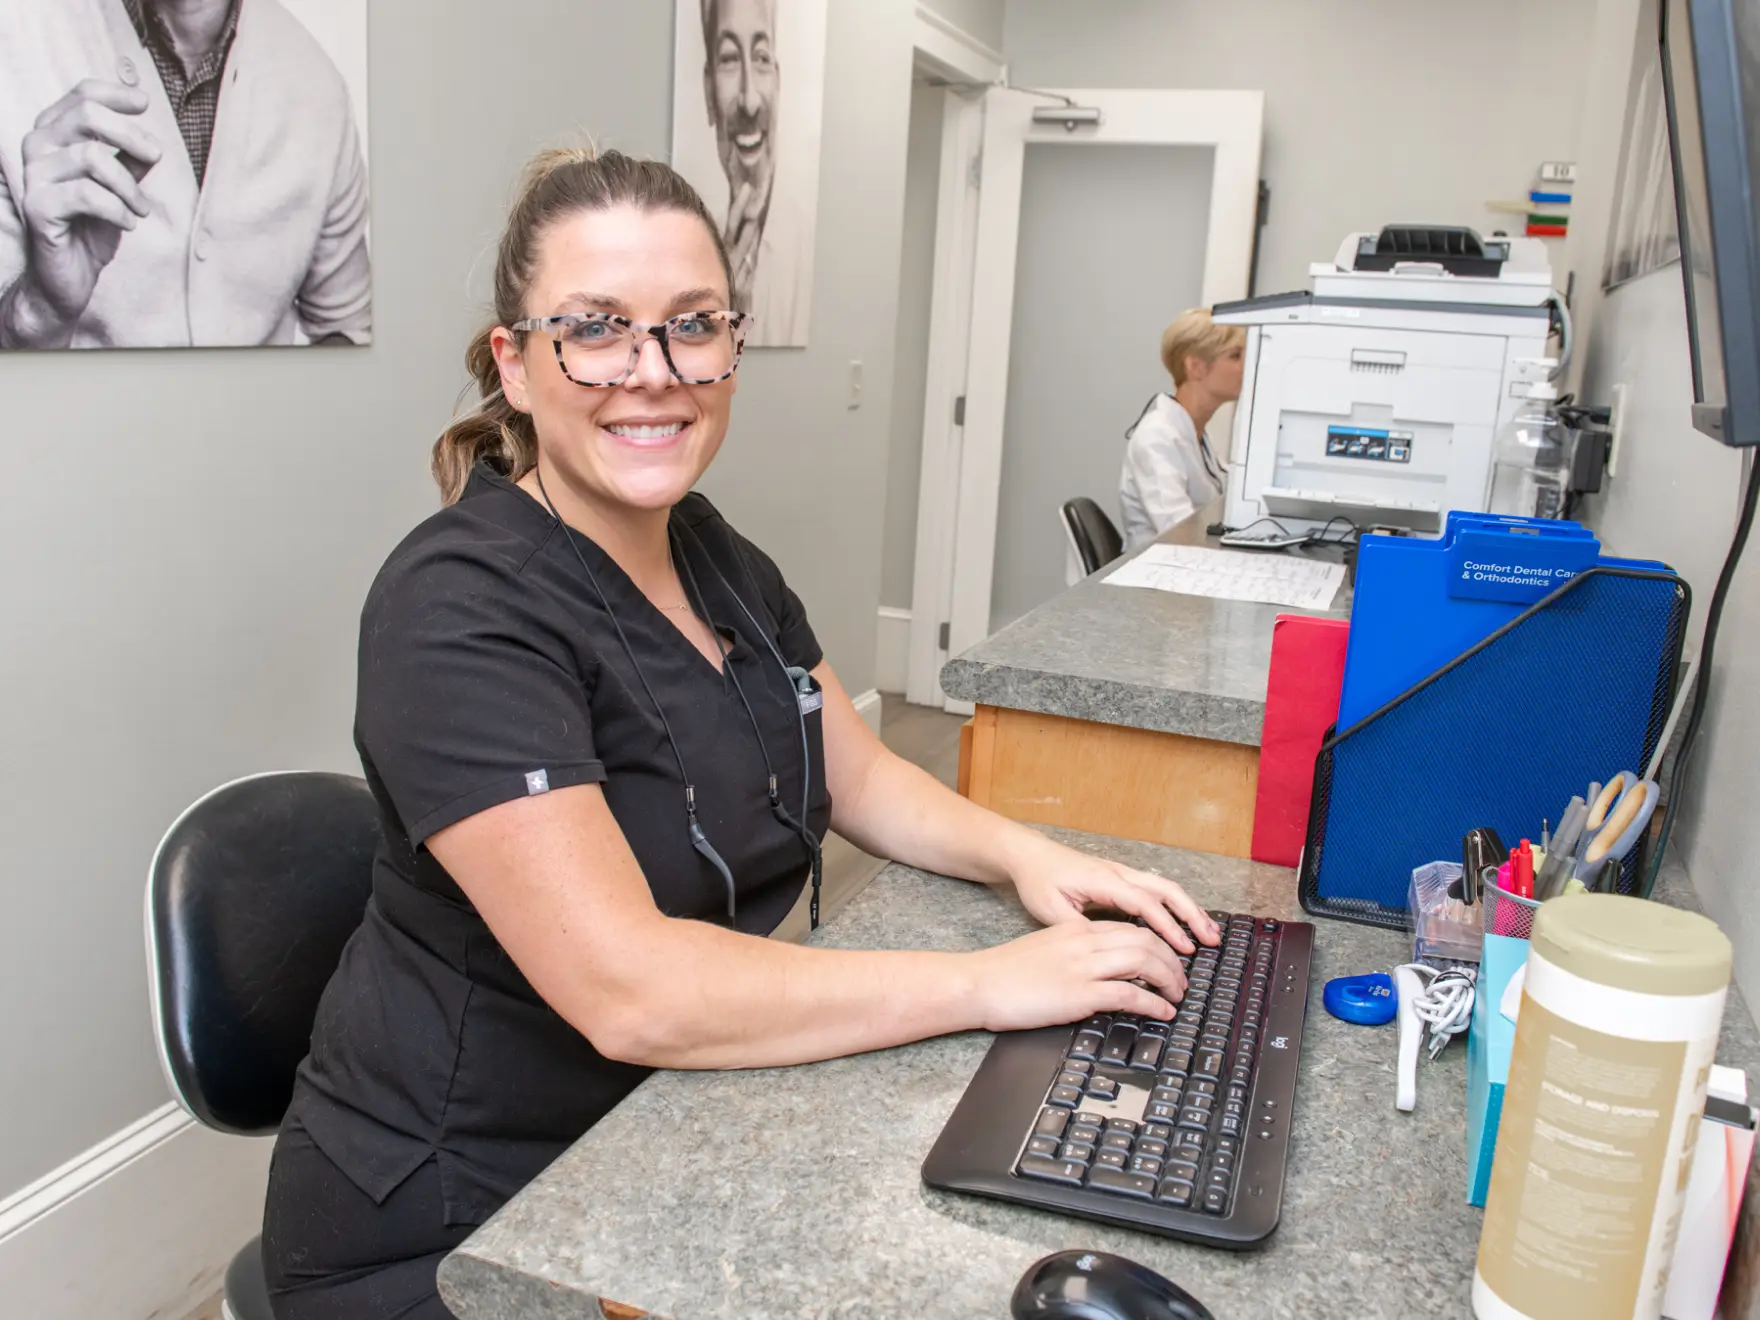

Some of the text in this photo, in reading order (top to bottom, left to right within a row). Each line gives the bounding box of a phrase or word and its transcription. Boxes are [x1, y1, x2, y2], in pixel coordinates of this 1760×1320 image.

[1463, 561, 1579, 578] Comfort Dental Car
[1461, 570, 1549, 587] & Orthodontics
[1270, 1036, 1289, 1049] logi
